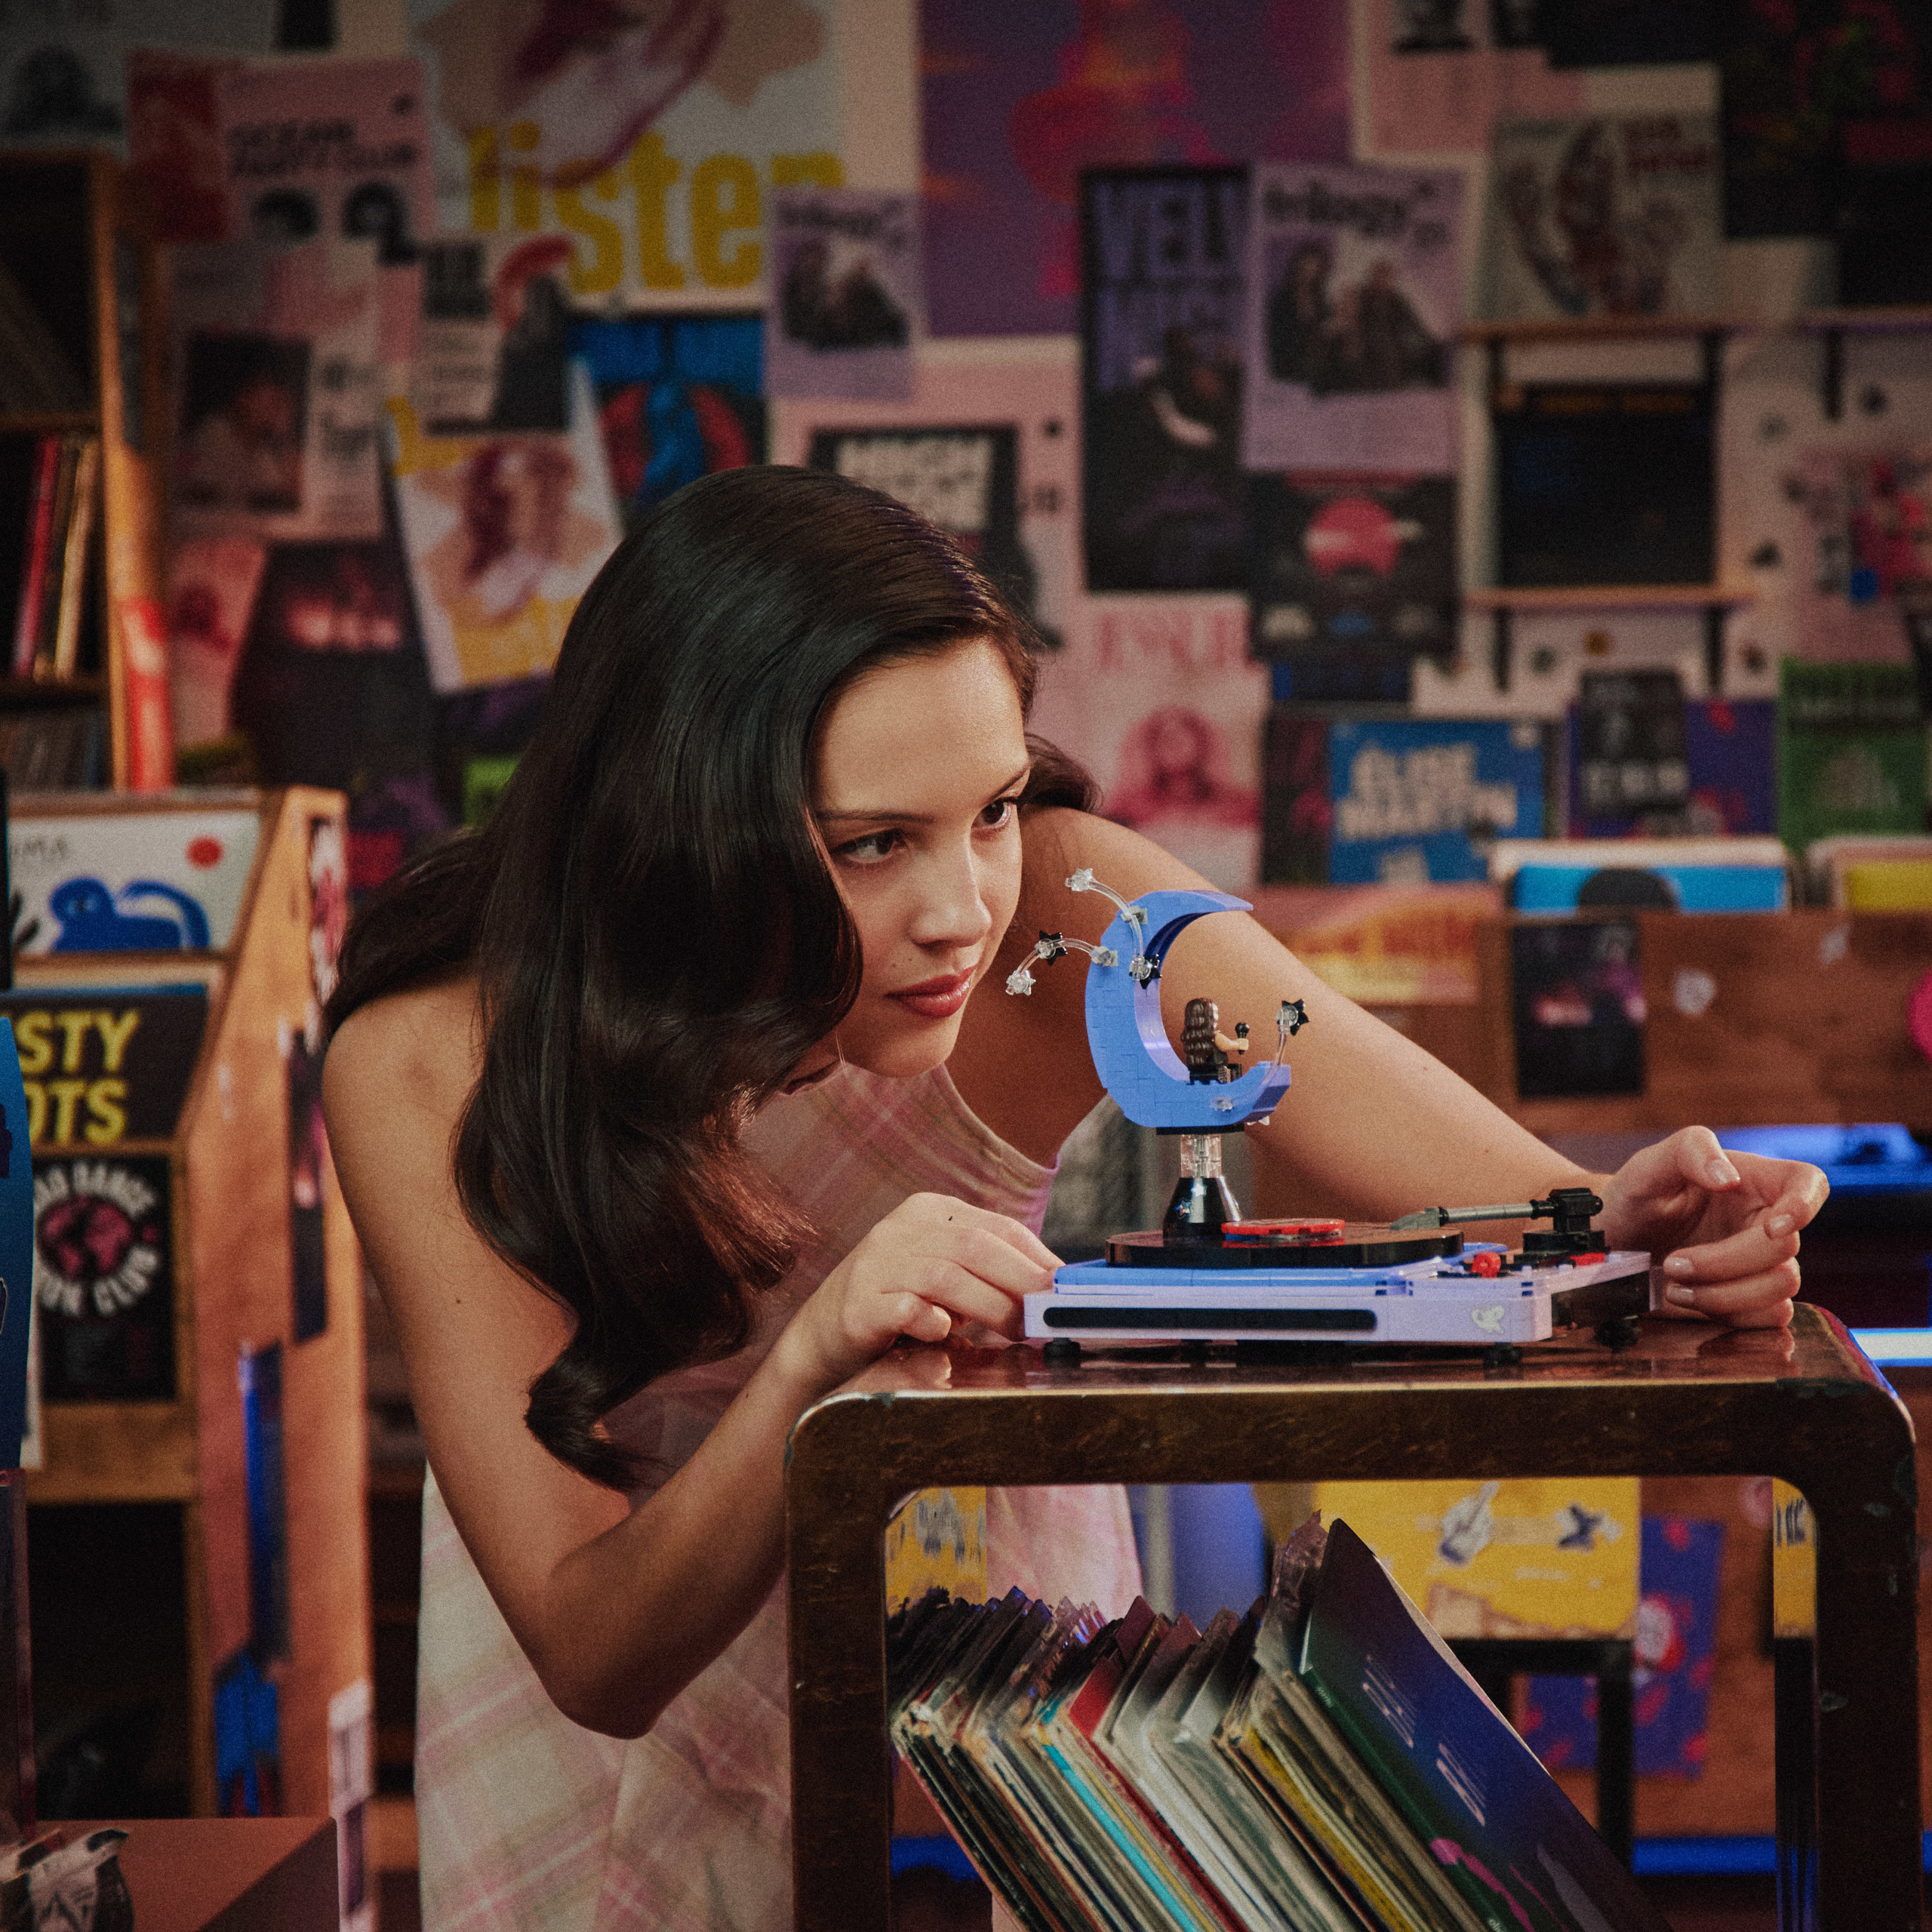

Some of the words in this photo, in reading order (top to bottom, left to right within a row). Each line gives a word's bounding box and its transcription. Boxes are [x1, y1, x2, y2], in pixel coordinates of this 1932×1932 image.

[469, 122, 845, 294] liste
[14, 1009, 141, 1075] STY
[23, 1078, 129, 1146] OTS
[92, 1246, 158, 1315] CLUB
